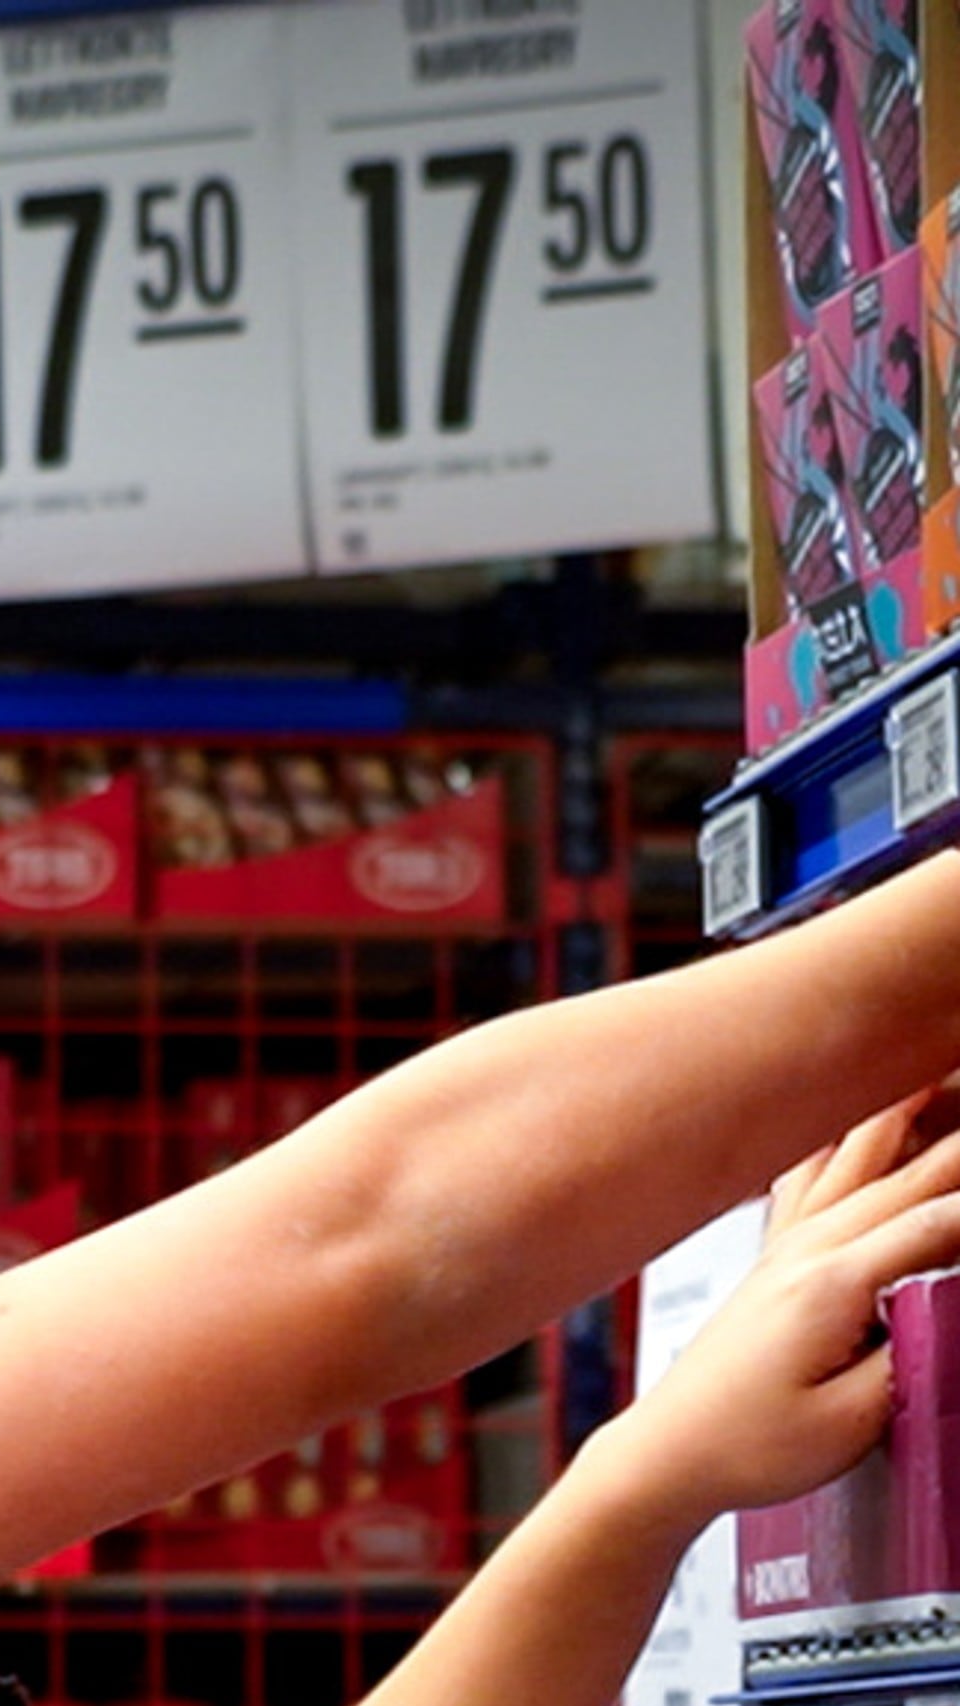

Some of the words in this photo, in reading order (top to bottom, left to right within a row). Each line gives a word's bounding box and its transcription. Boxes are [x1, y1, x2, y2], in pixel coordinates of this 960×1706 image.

[135, 176, 242, 314] 50
[346, 143, 517, 440] 17
[542, 133, 651, 275] 50
